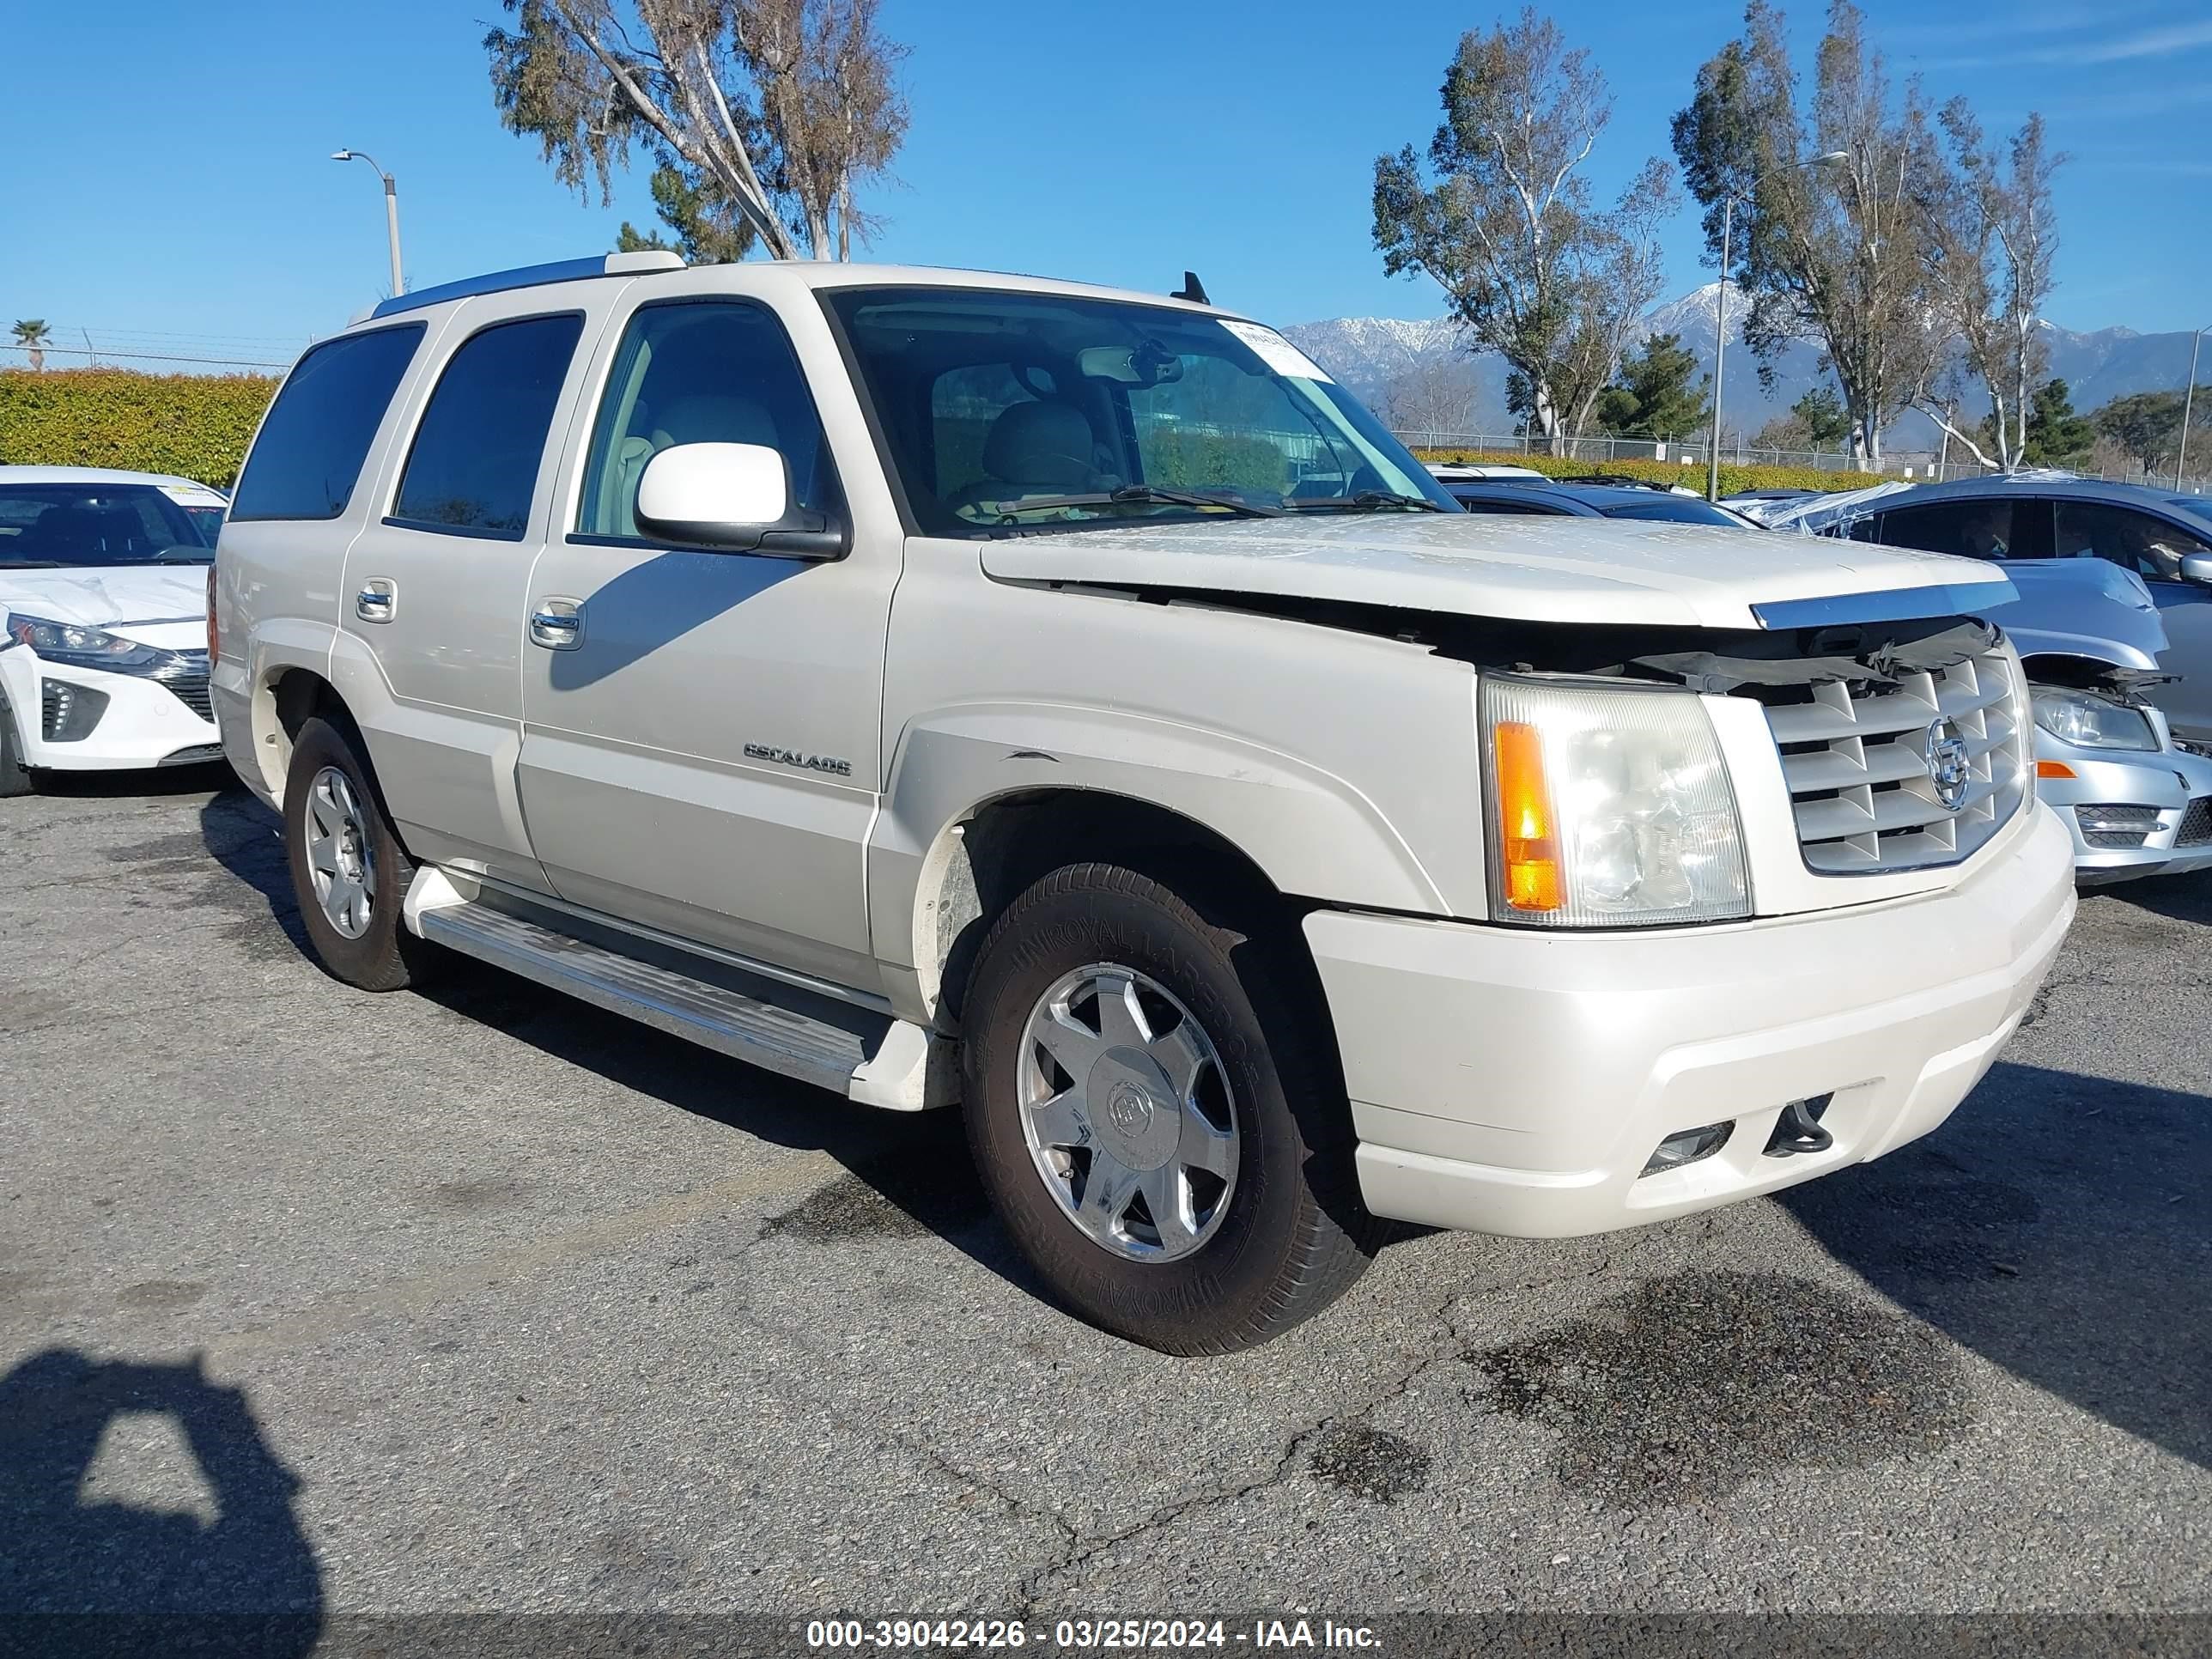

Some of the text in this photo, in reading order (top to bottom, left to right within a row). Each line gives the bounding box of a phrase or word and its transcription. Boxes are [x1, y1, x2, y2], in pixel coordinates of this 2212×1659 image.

[744, 742, 853, 776] ESCALADE
[1009, 915, 1134, 973] UNIROYAL
[1096, 1274, 1224, 1316] UNIROYAL
